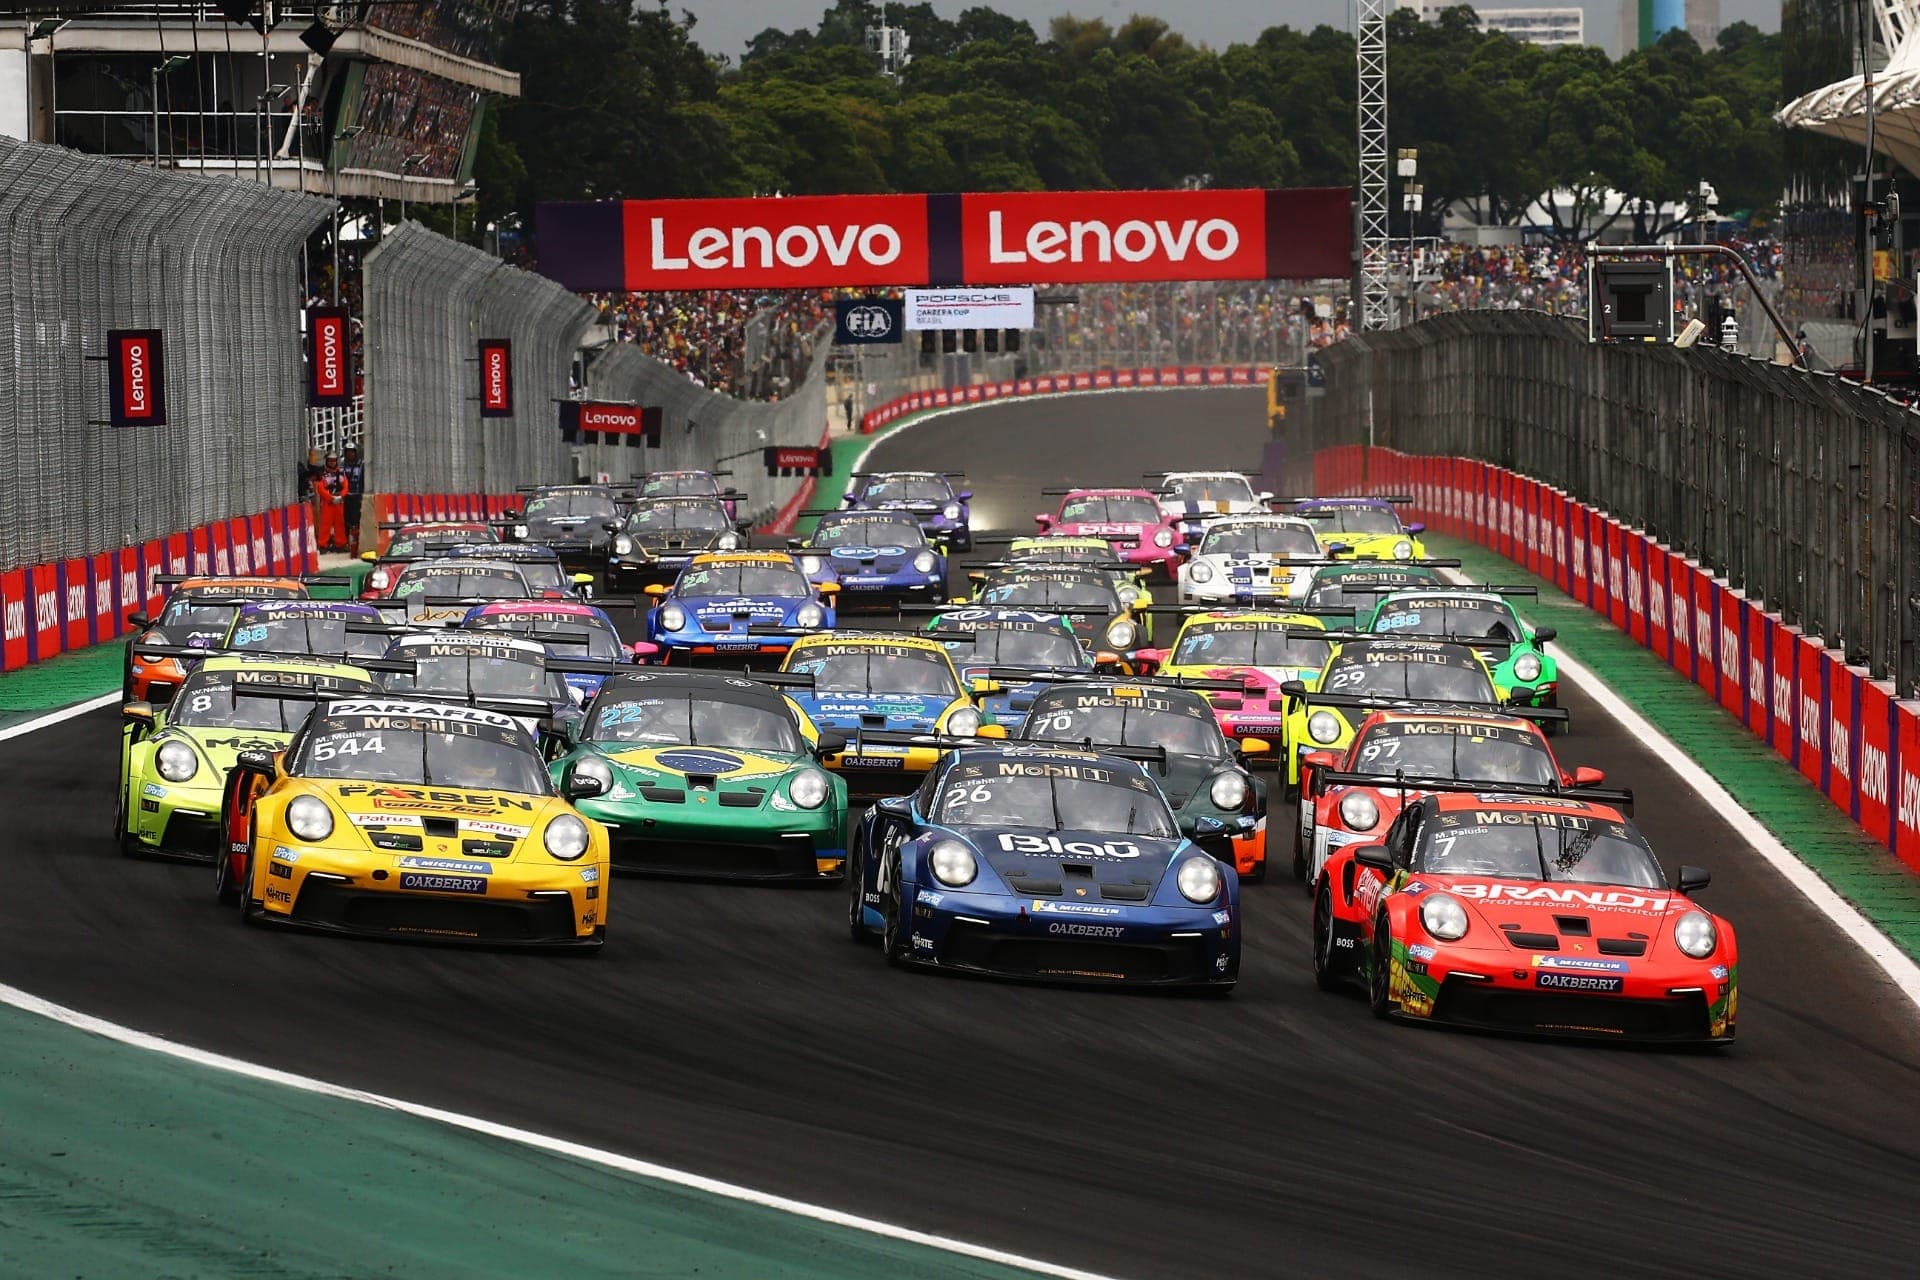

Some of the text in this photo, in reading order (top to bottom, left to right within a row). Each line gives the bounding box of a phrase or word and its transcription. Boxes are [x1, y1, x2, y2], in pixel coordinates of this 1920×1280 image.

[651, 217, 901, 270] Lenovo
[989, 210, 1239, 264] Lenovo
[916, 294, 1010, 303] PORSCHE
[916, 308, 970, 317] CARRERA CUP
[1604, 304, 1612, 314] 2
[323, 324, 337, 389] Lenovo
[130, 345, 145, 411] Lenovo
[489, 353, 502, 405] Lenovo
[585, 411, 637, 426] Lenovo
[840, 516, 877, 525] Mobil
[1029, 547, 1071, 555] Mobil
[710, 561, 755, 569] Mobil
[1223, 559, 1281, 567] BOS
[426, 567, 473, 577] Mobil
[1341, 574, 1388, 583] Mobil
[1015, 575, 1061, 583] Mobil
[203, 586, 254, 595] Mobil
[35, 586, 58, 632] Lenovo
[696, 606, 784, 615] SEGURALTA
[1408, 600, 1459, 609] Mobil
[3, 593, 25, 640] Lenovo
[268, 611, 324, 621] Mobil
[499, 613, 552, 622] Mobil
[959, 622, 1012, 631] Mobil
[1214, 622, 1267, 632] Mobil
[234, 627, 268, 646] 88
[430, 646, 492, 657] Mobil
[827, 646, 885, 655] Mobil
[1366, 652, 1424, 662] Mobil
[236, 672, 309, 685] Mobil
[1333, 671, 1366, 689] 29
[191, 695, 212, 712] 8
[821, 704, 869, 712] DURA
[1077, 696, 1143, 708] Mobil
[330, 704, 511, 727] PARAFLU
[601, 706, 643, 728] 22
[364, 716, 446, 732] Mobil
[1034, 716, 1072, 735] 70
[1236, 725, 1281, 734] OAKBERR
[1404, 723, 1472, 736] Mobil
[315, 736, 329, 744] M.
[314, 737, 386, 762] 544
[1363, 742, 1401, 762] 97
[845, 757, 901, 767] OAKBERRY
[1861, 724, 1888, 806] Lenovo
[999, 763, 1079, 778] Mobil
[954, 778, 995, 789] C. Hahn
[338, 785, 533, 811] FARBEN
[946, 784, 992, 809] 26
[358, 815, 413, 824] Patrus
[1476, 811, 1557, 827] Mobil
[469, 820, 522, 835] Patrus
[1435, 827, 1489, 840] M. Paludo
[232, 843, 248, 854] BOSS
[1435, 836, 1457, 857] 7
[421, 859, 485, 872] MICHELIN
[405, 875, 483, 892] OAKBERRY
[865, 893, 880, 904] BOSS
[1450, 884, 1673, 911] BRANDT
[1060, 905, 1120, 914] MICHELIN
[1479, 898, 1677, 917] Professional Agriculture
[1049, 923, 1125, 938] OAKBERRY
[1336, 937, 1354, 949] BOSS
[1559, 958, 1620, 969] MICHELIN
[1540, 974, 1619, 991] OAKBERRY
